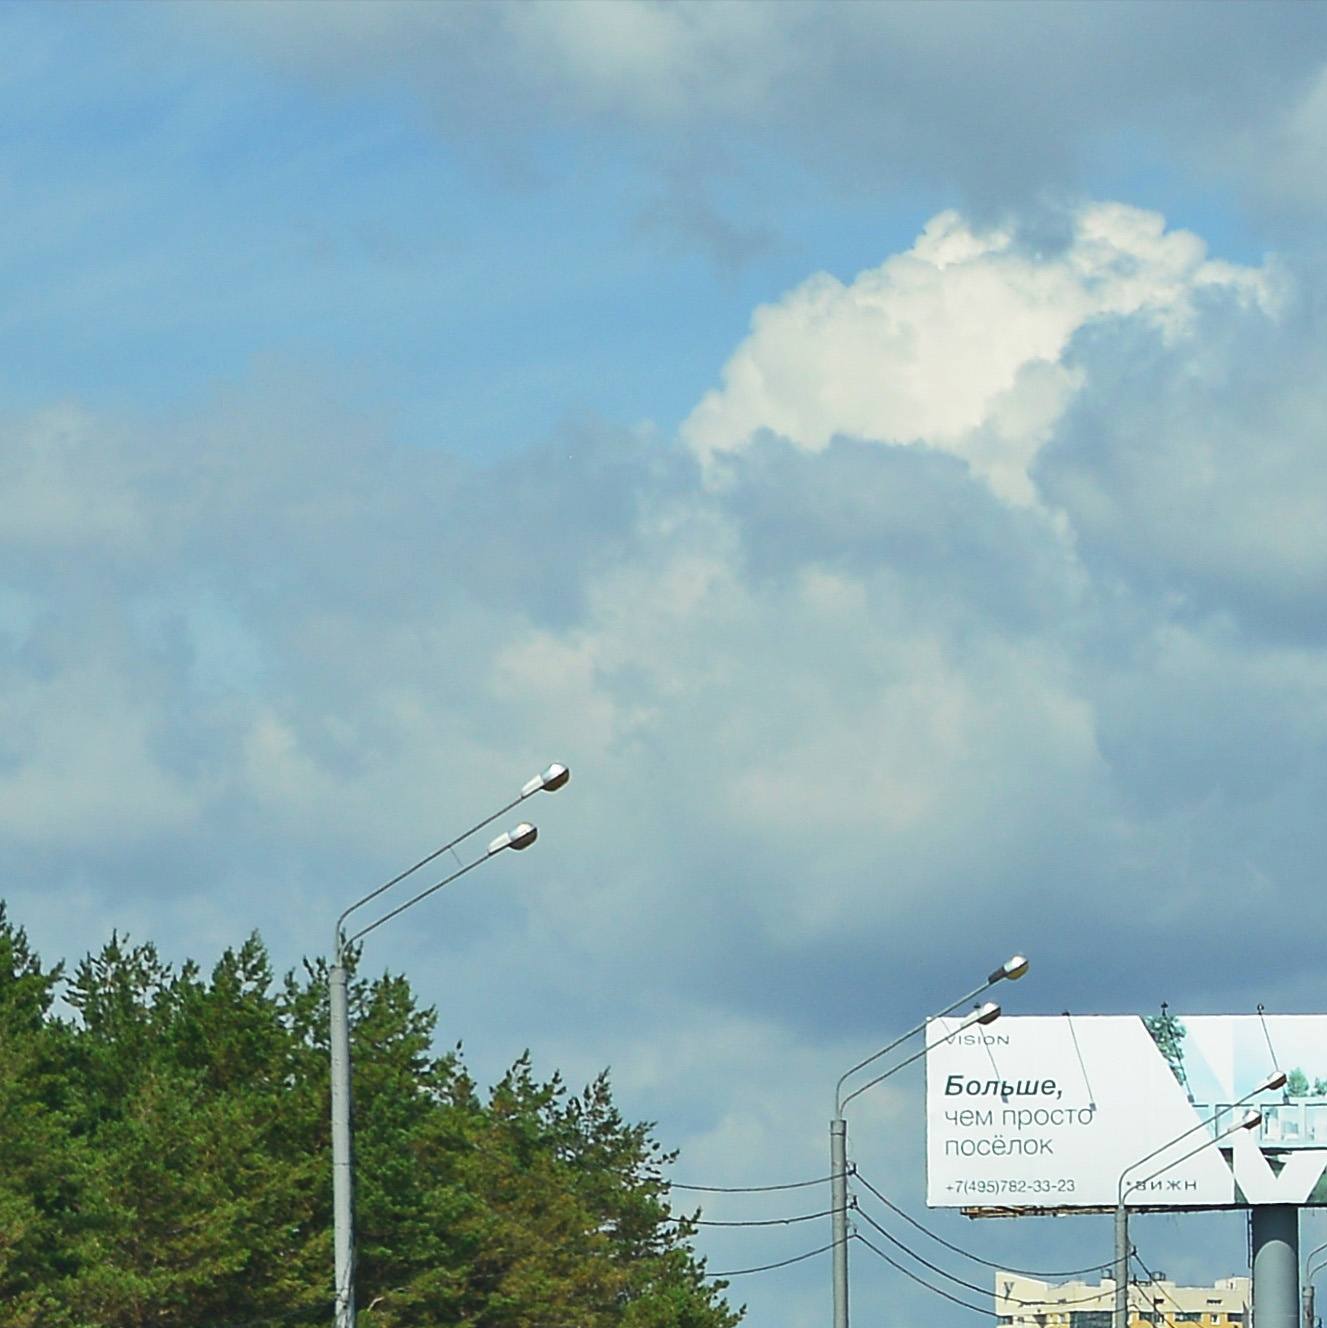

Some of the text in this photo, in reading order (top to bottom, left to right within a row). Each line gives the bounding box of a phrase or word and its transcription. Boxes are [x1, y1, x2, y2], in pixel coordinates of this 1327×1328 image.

[946, 1035, 1010, 1045] VISION
[945, 1075, 1062, 1100] Больше,
[945, 1108, 1093, 1130] чем просто
[945, 1134, 1053, 1156] посёлок
[946, 1179, 1076, 1196] +7(495)782-33-23
